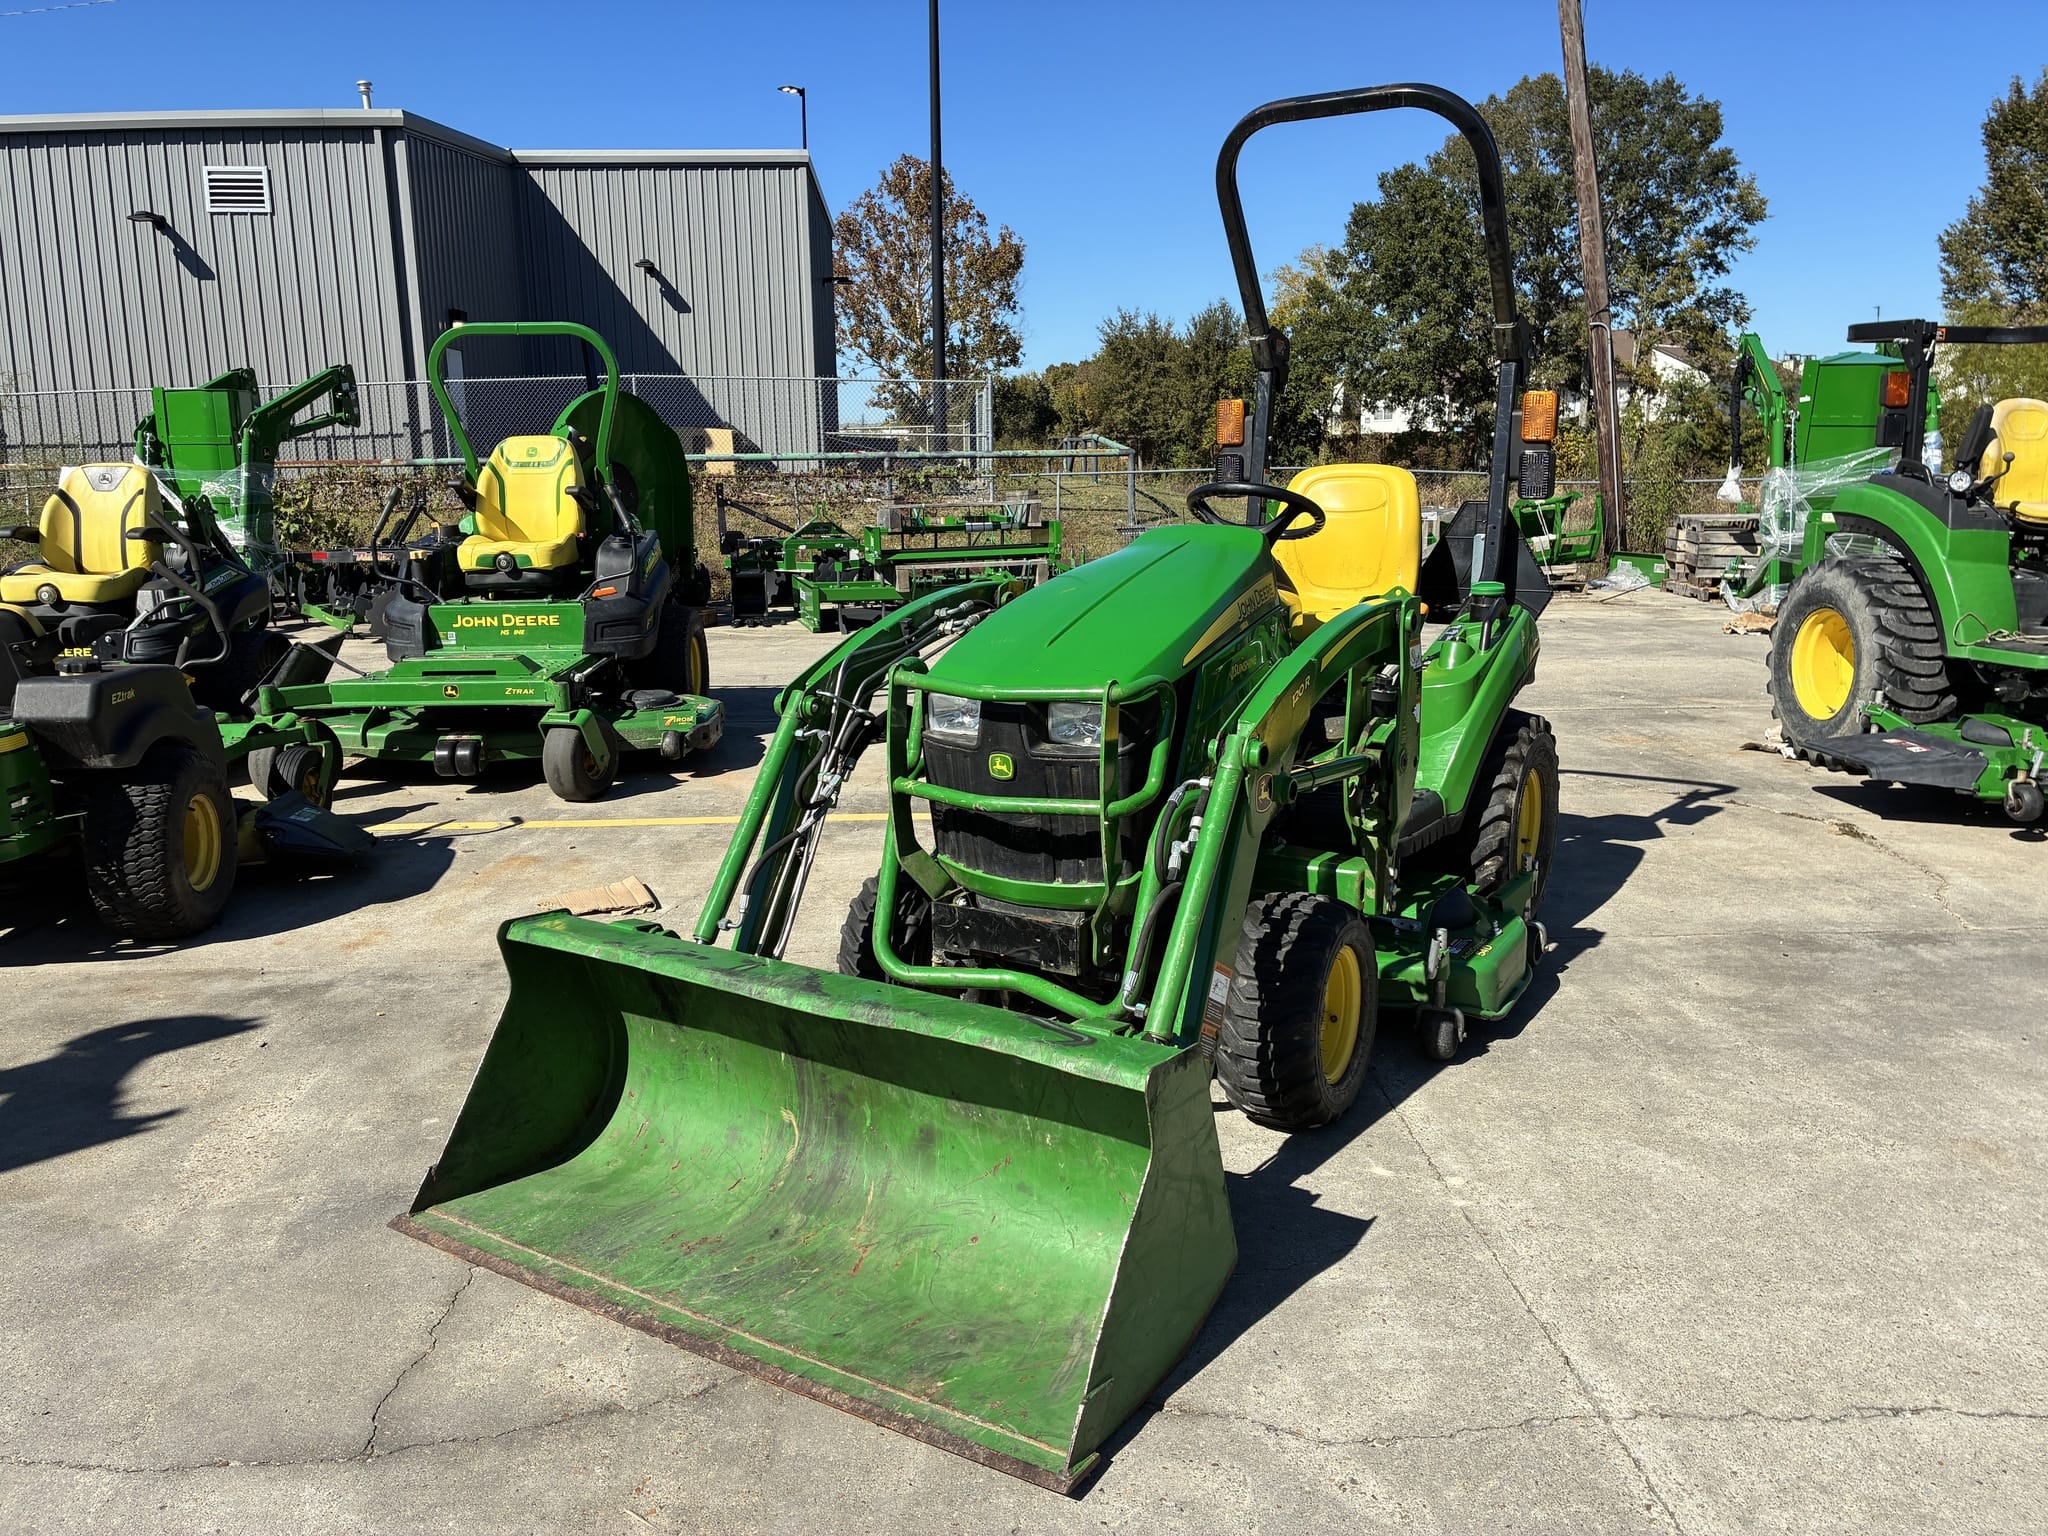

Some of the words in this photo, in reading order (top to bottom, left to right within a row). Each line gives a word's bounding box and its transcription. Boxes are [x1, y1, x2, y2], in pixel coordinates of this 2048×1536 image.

[1239, 595, 1256, 620] JOHN
[1254, 584, 1273, 609] DEERE
[453, 614, 498, 628] JOHN
[502, 613, 560, 627] DEERE
[111, 688, 136, 705] EZtrak
[505, 687, 534, 695] ZTRAK
